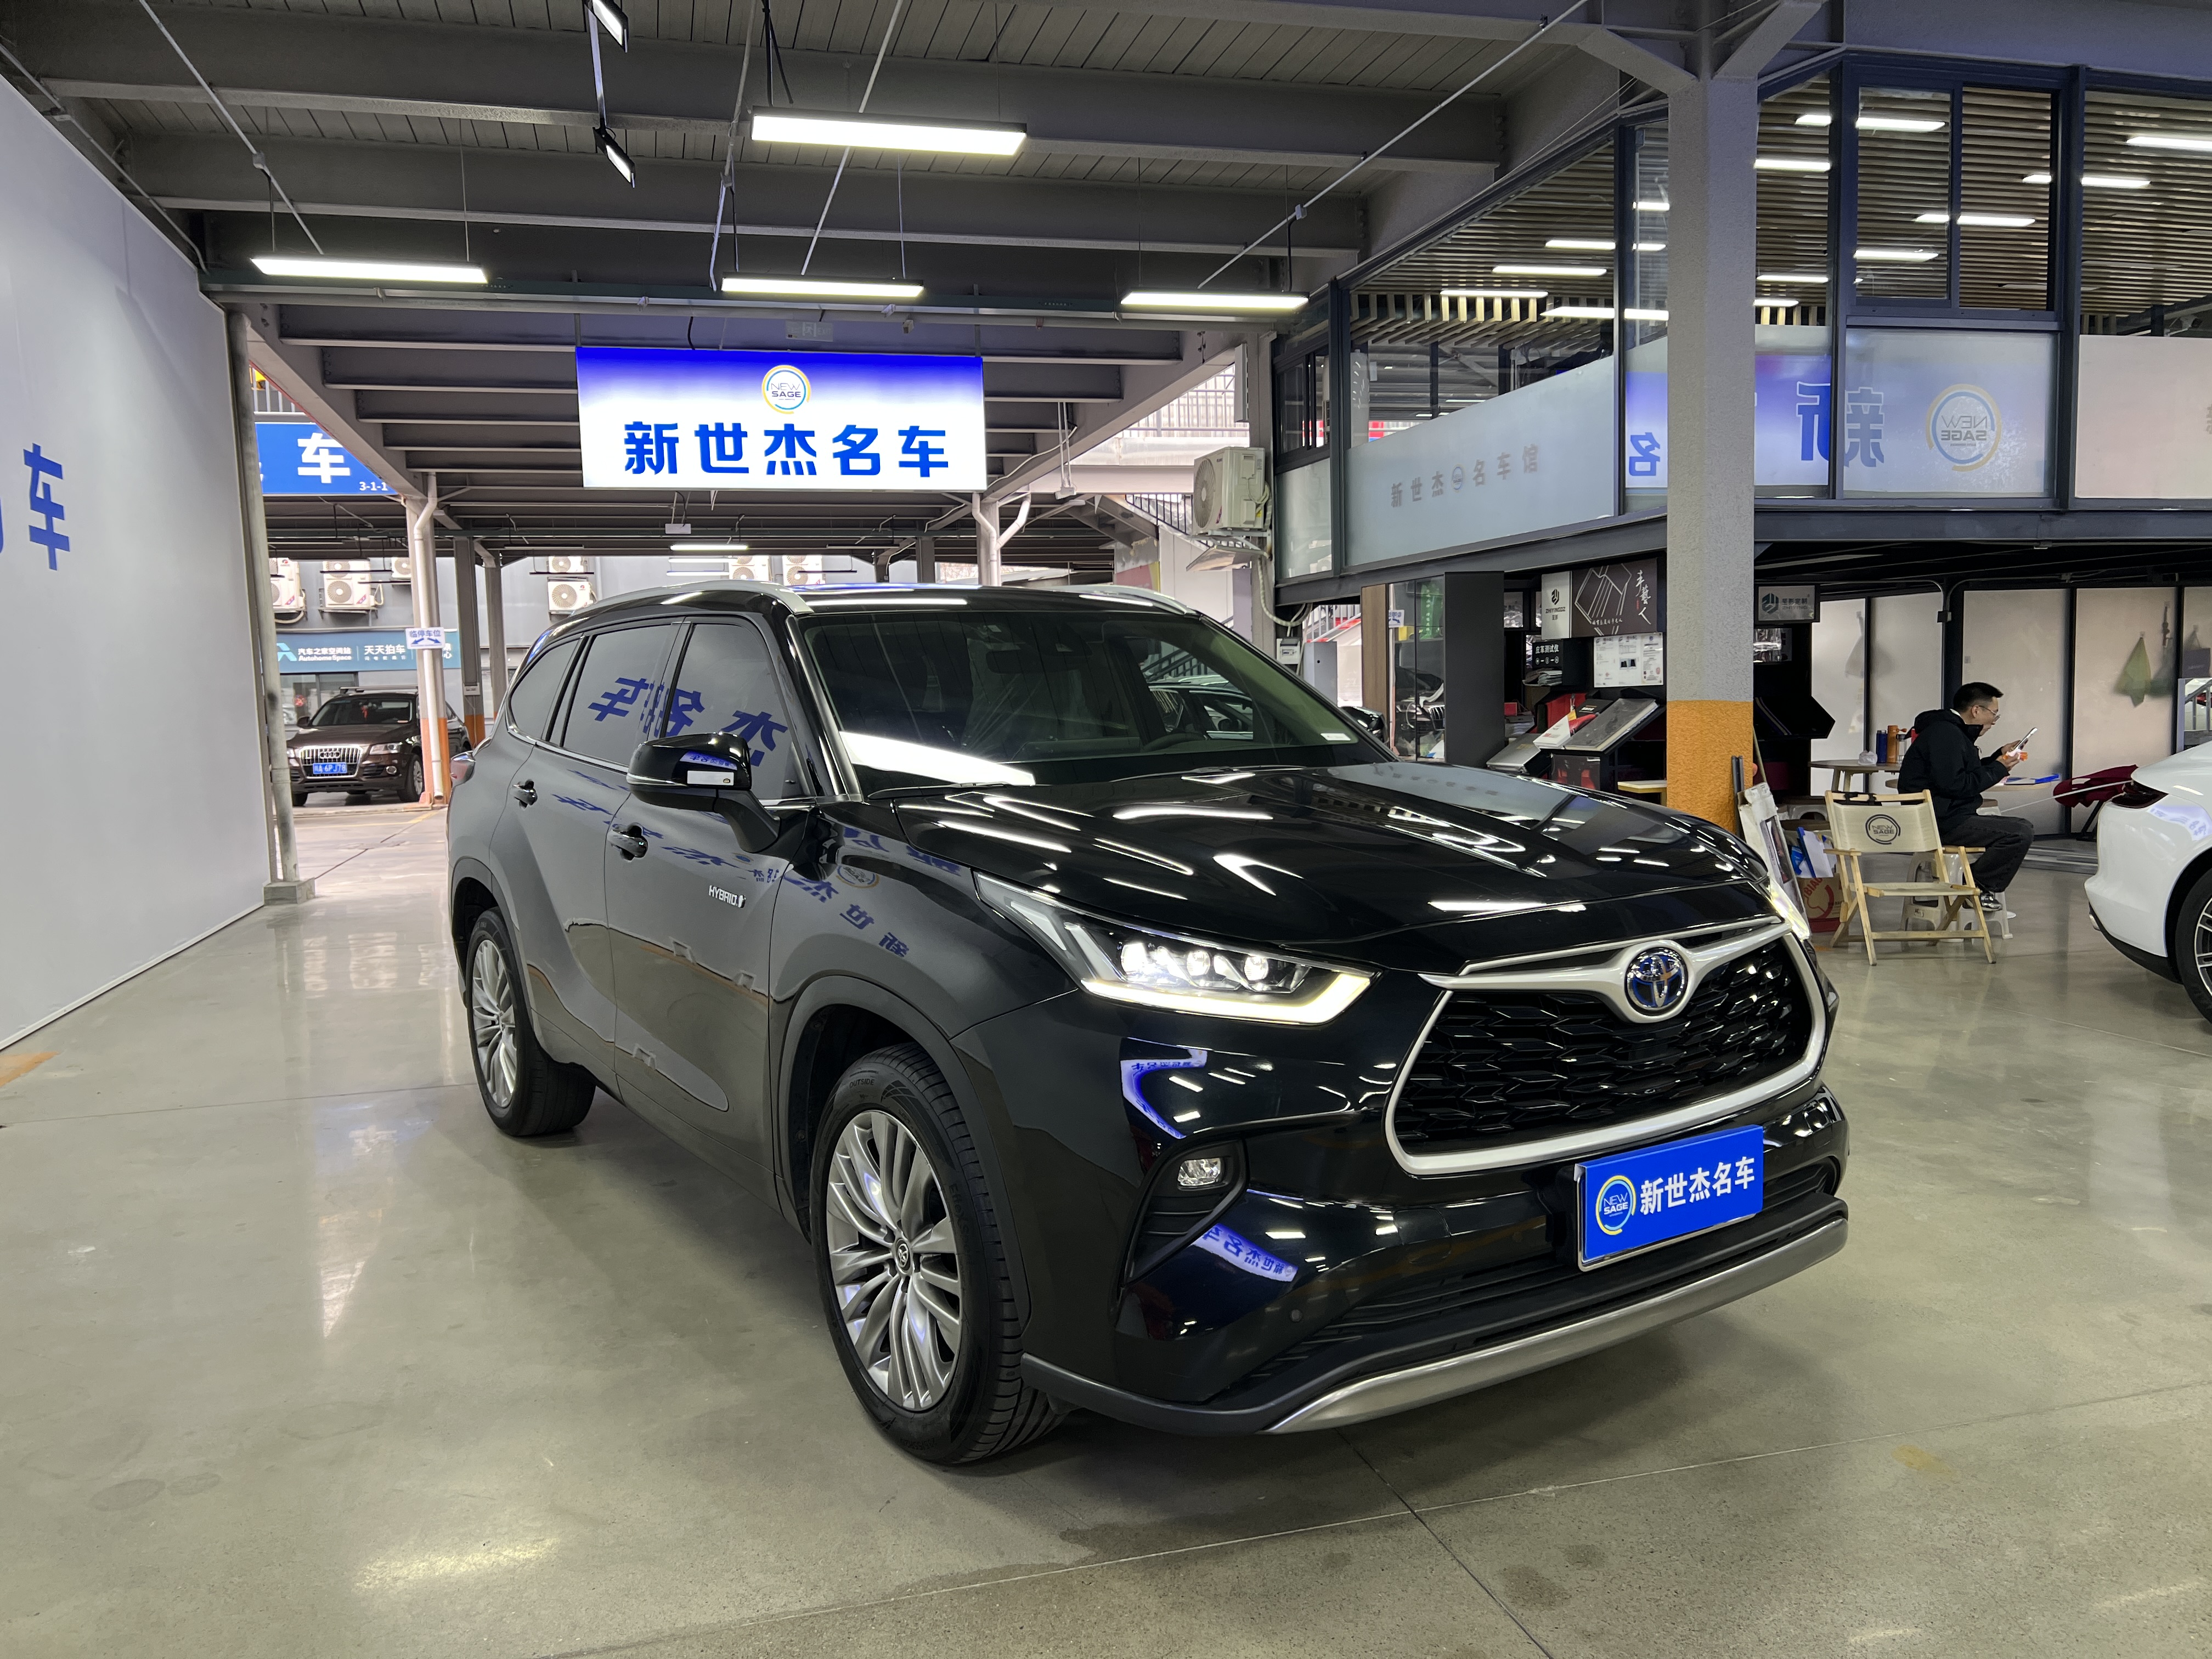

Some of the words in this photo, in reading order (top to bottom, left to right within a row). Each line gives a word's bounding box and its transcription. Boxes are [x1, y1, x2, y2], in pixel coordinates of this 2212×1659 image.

[771, 382, 800, 391] NEW
[624, 421, 949, 477] 新世杰名车
[297, 432, 351, 484] 车
[409, 629, 441, 638] 临停车位
[364, 644, 406, 655] 天天拍车
[709, 885, 737, 906] HYBRID
[849, 1079, 875, 1088] OUTSIDE
[1640, 1156, 1755, 1215] 新世杰名车
[1603, 1192, 1628, 1206] NEW
[1604, 1202, 1629, 1215] SAGE
